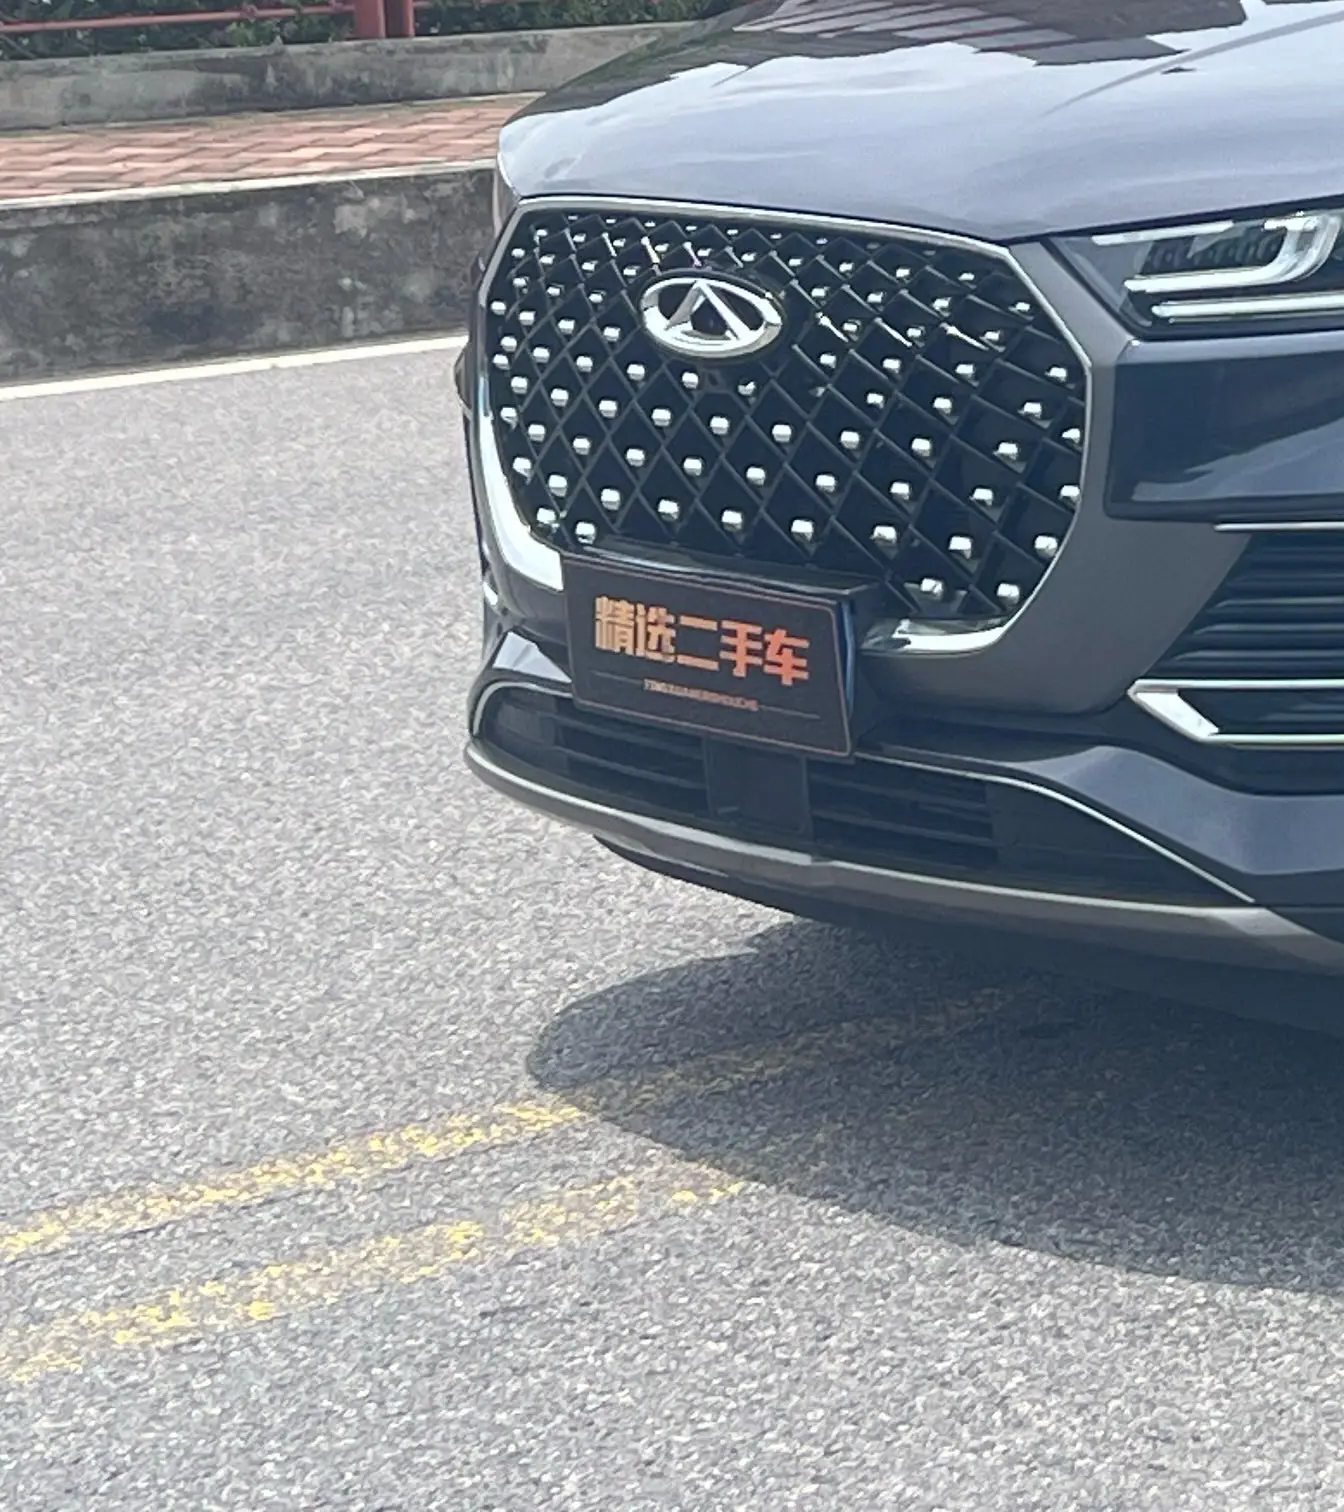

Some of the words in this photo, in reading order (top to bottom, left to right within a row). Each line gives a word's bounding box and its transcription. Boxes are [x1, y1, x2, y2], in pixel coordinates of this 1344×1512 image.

[595, 596, 810, 686] 精选二手车
